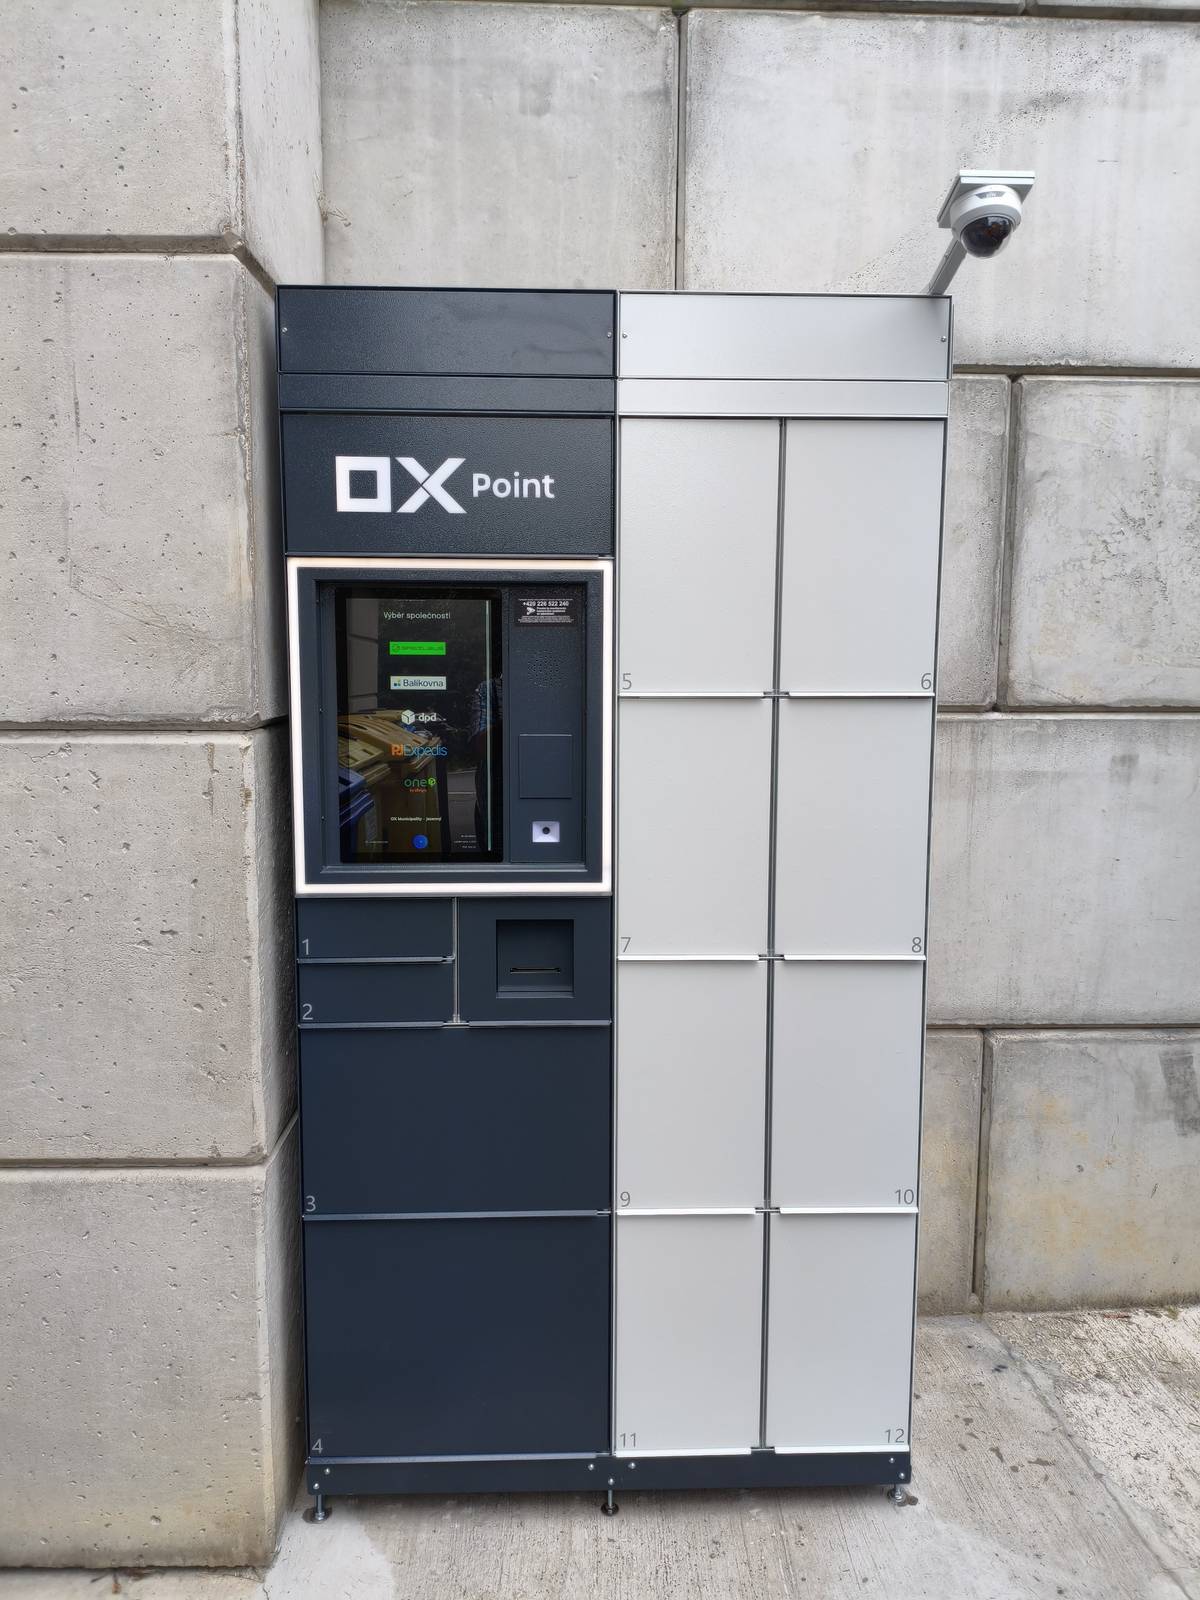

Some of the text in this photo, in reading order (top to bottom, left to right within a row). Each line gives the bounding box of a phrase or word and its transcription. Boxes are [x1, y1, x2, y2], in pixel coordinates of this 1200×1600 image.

[335, 455, 556, 514] OX Point
[620, 673, 632, 689] 5
[921, 673, 932, 690] 6
[418, 712, 437, 723] dpd
[301, 938, 309, 956] 1
[620, 936, 631, 953] 7
[911, 936, 922, 953] 8
[302, 1003, 314, 1021] 2
[306, 1195, 317, 1213] 3
[619, 1191, 631, 1208] 9
[895, 1189, 914, 1206] 10
[620, 1432, 637, 1448] 11
[885, 1428, 905, 1445] 12
[311, 1438, 324, 1455] 4
